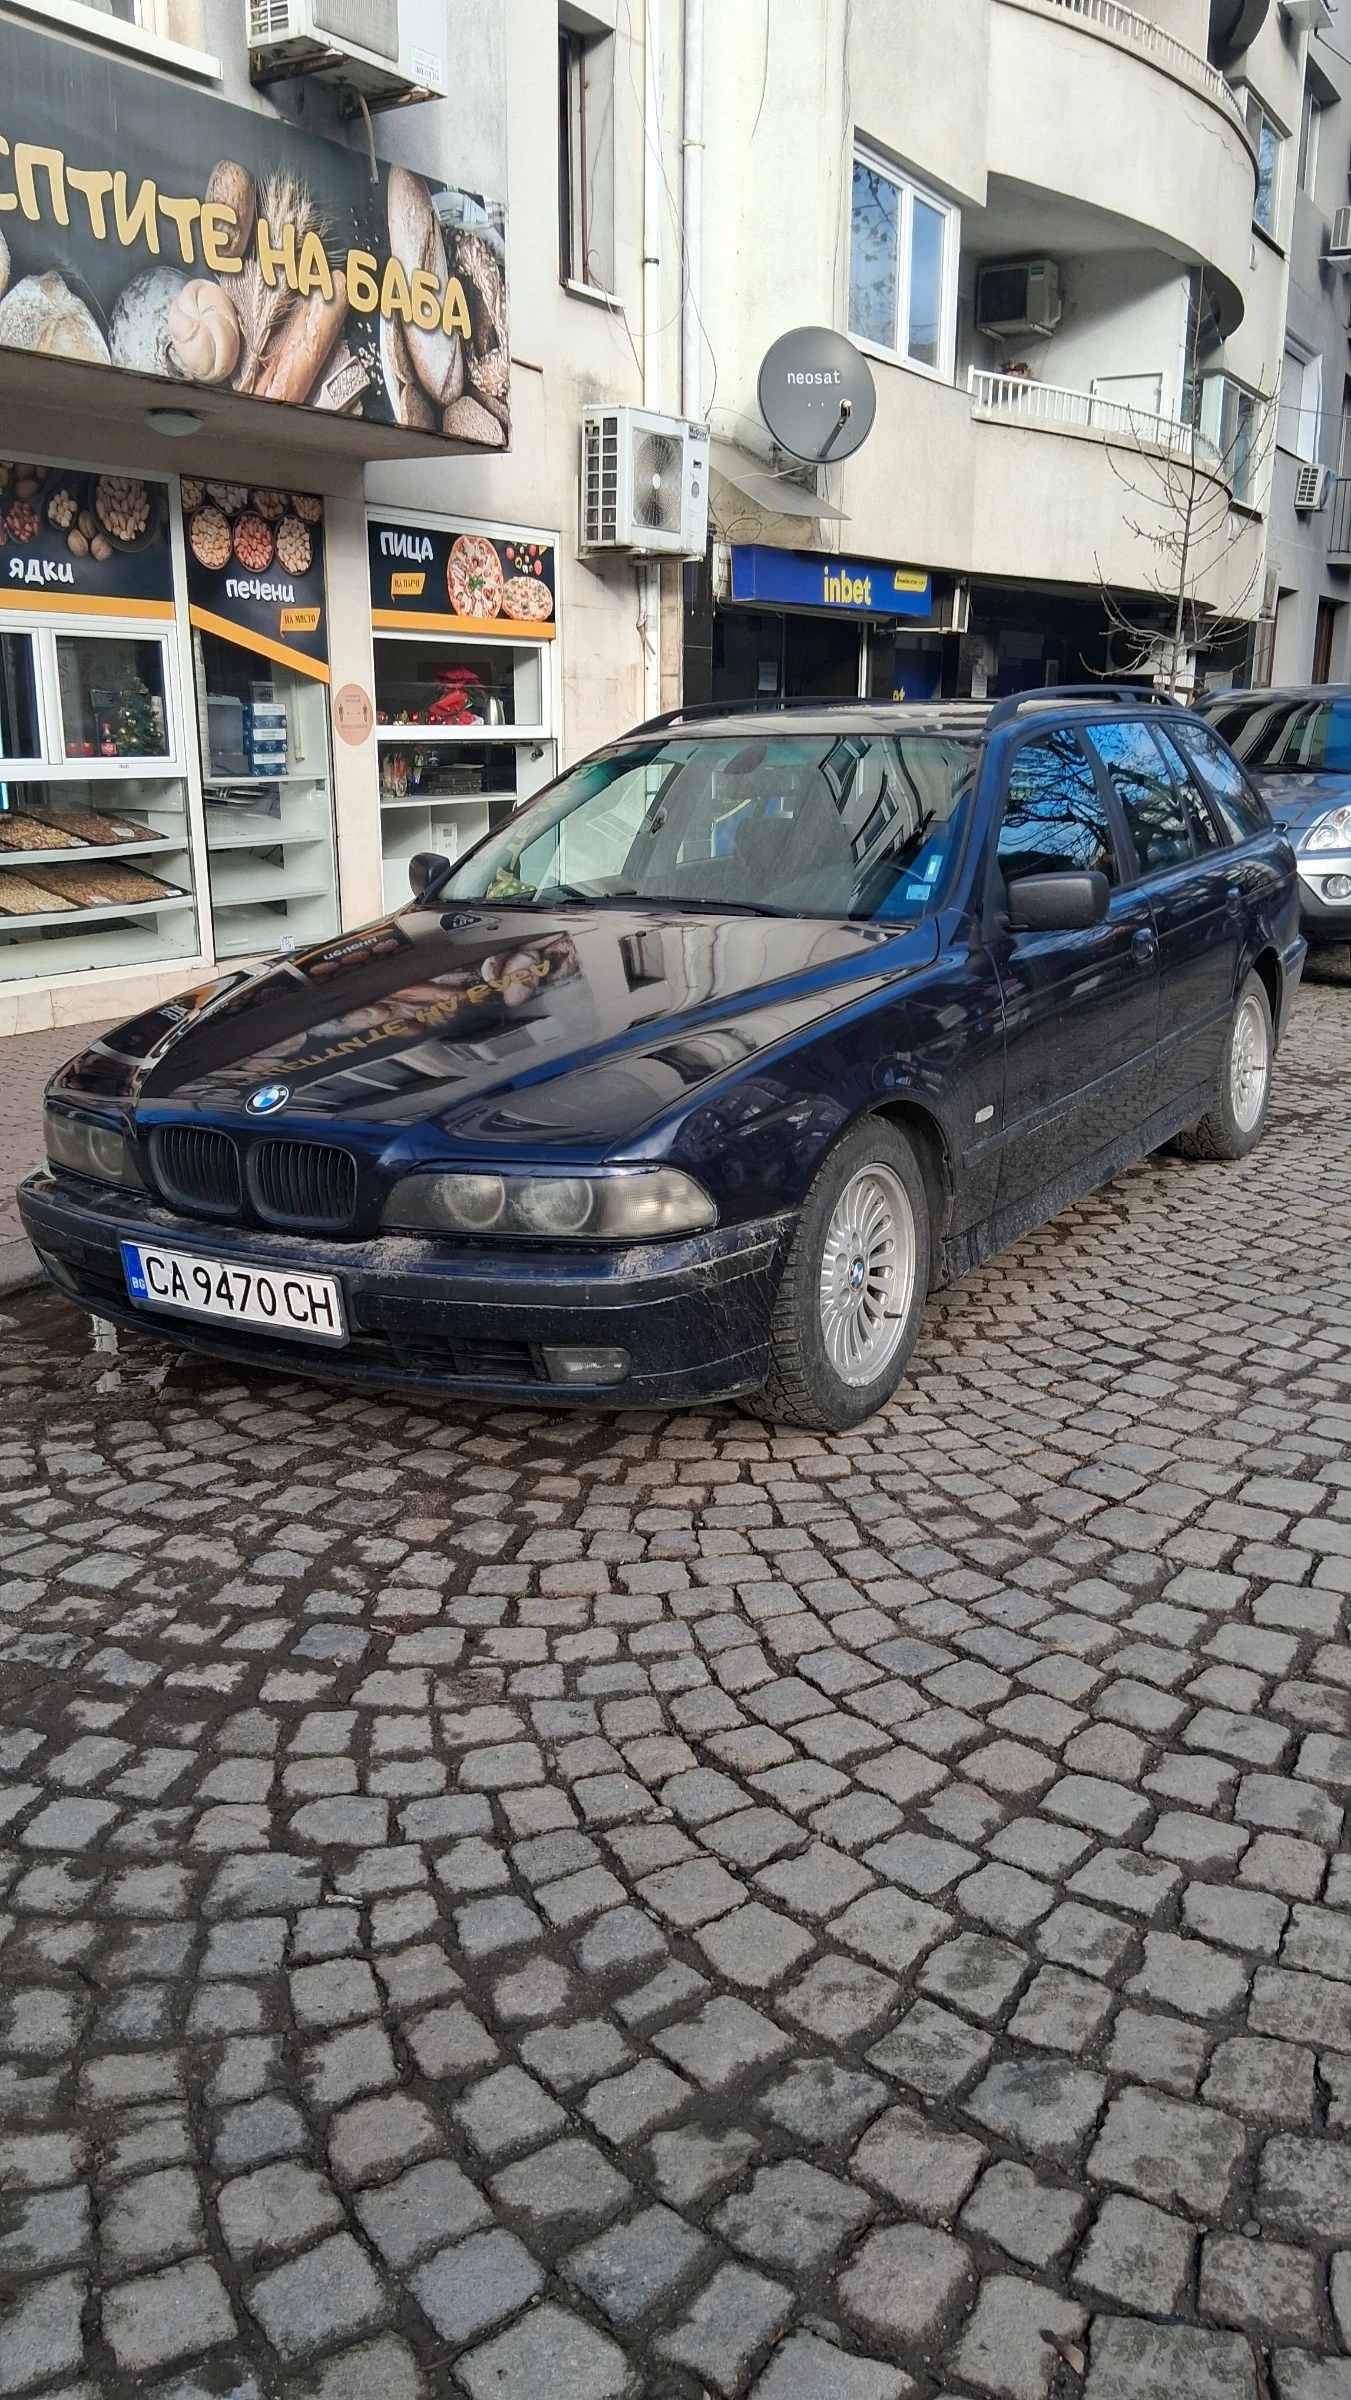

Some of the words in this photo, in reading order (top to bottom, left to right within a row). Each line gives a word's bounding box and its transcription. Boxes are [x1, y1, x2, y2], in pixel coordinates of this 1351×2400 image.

[257, 218, 334, 301] НА
[346, 249, 472, 340] БАБА
[787, 369, 841, 385] neosat
[380, 531, 434, 563] ПИЦА
[225, 578, 296, 603] печени
[824, 565, 872, 606] inbet
[131, 1276, 146, 1290] BG
[145, 1256, 191, 1301] CA
[192, 1266, 278, 1317] 9470
[283, 1281, 335, 1328] CH
